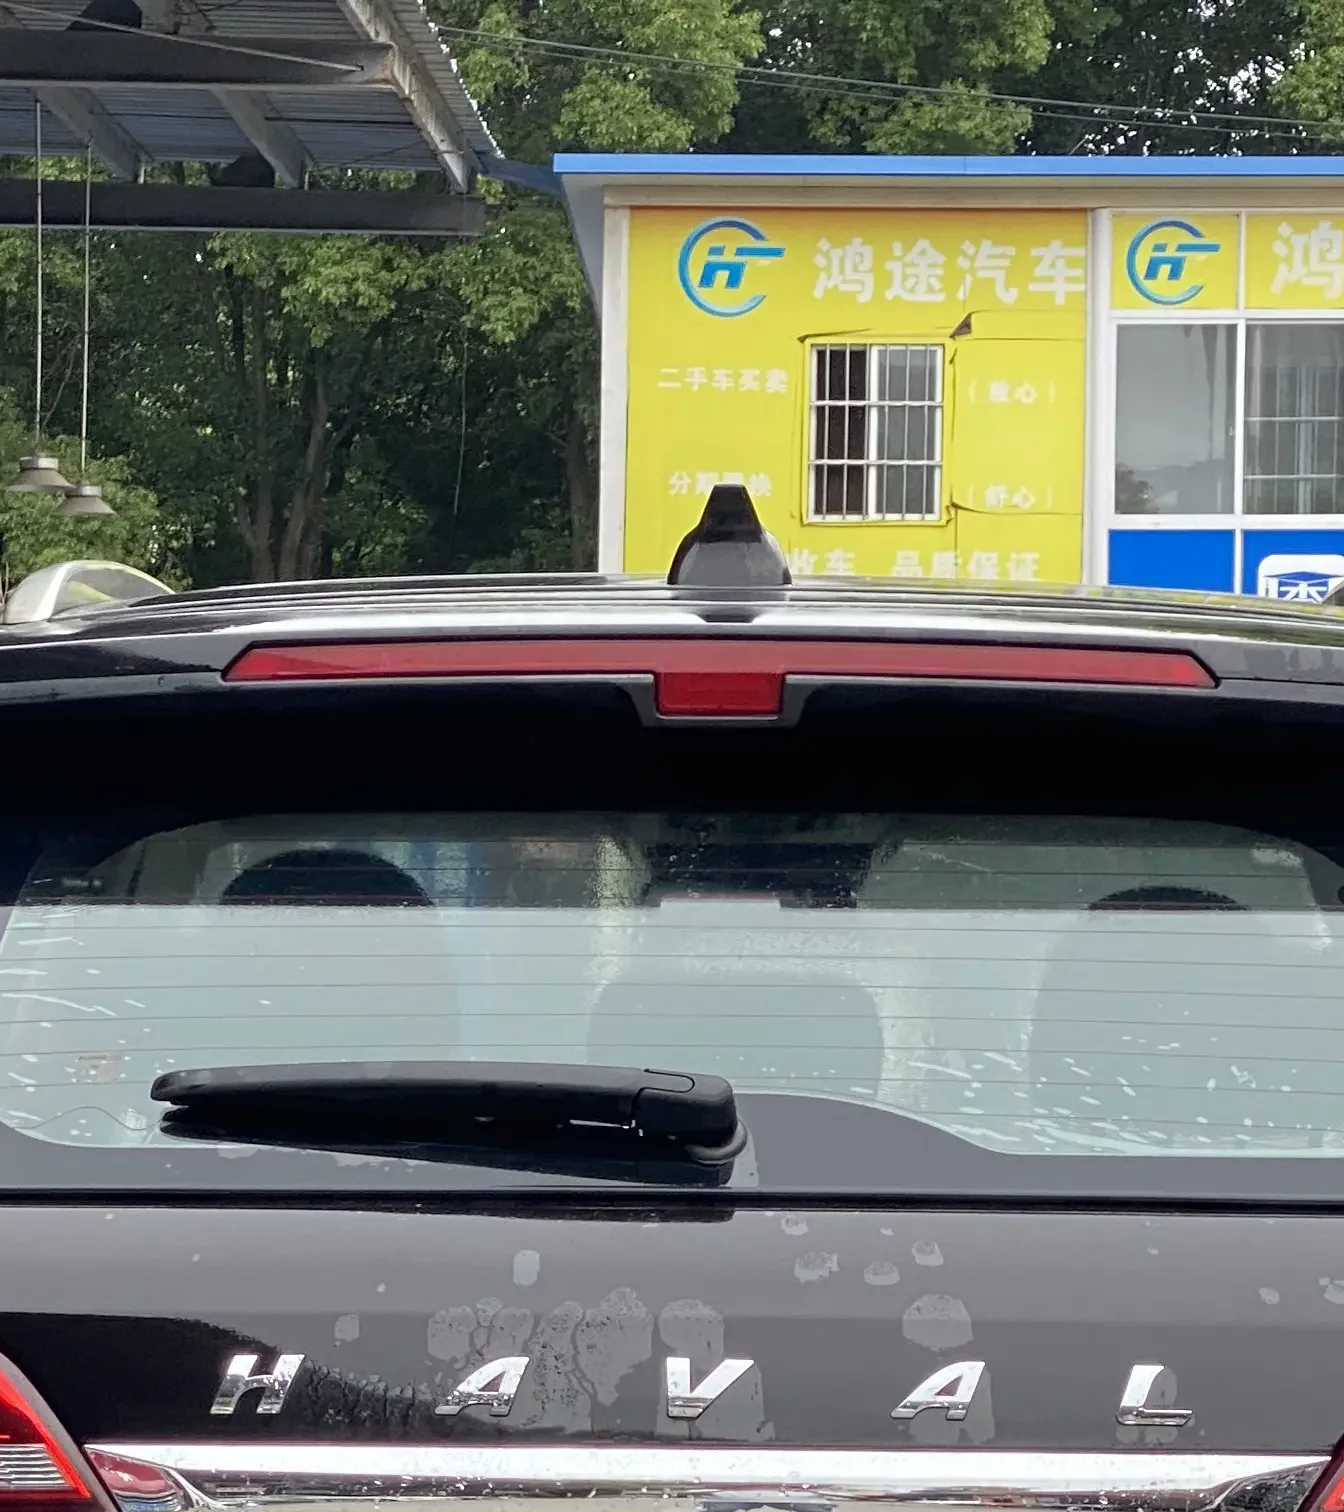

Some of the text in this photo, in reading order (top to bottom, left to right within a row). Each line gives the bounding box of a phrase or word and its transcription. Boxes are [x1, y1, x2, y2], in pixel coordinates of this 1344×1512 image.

[813, 238, 1087, 304] 鸿途汽车
[657, 367, 789, 393] 二手车买卖
[209, 1353, 1194, 1426] HAVAL
